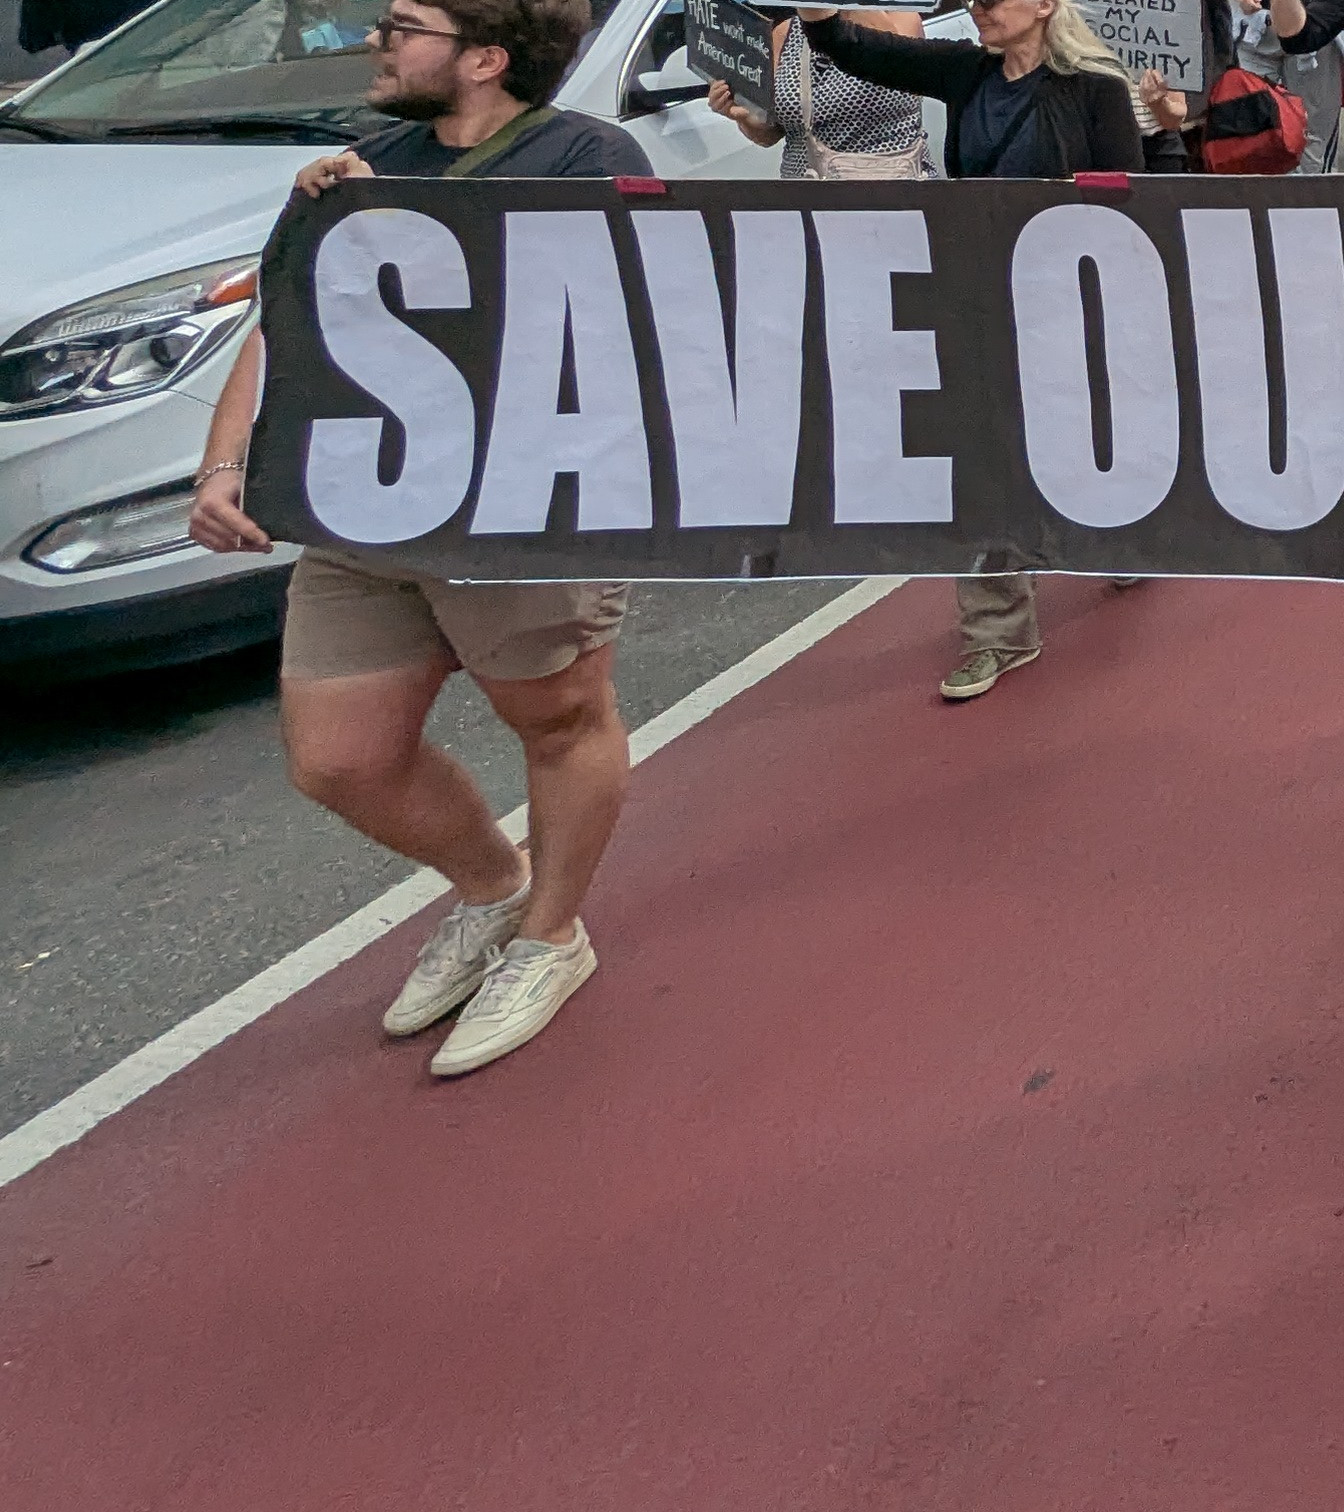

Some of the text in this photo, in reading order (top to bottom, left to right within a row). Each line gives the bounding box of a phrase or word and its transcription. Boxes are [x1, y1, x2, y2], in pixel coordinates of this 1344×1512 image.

[1105, 6, 1140, 24] MY
[698, 31, 735, 70] America
[305, 206, 953, 544] SAVE
